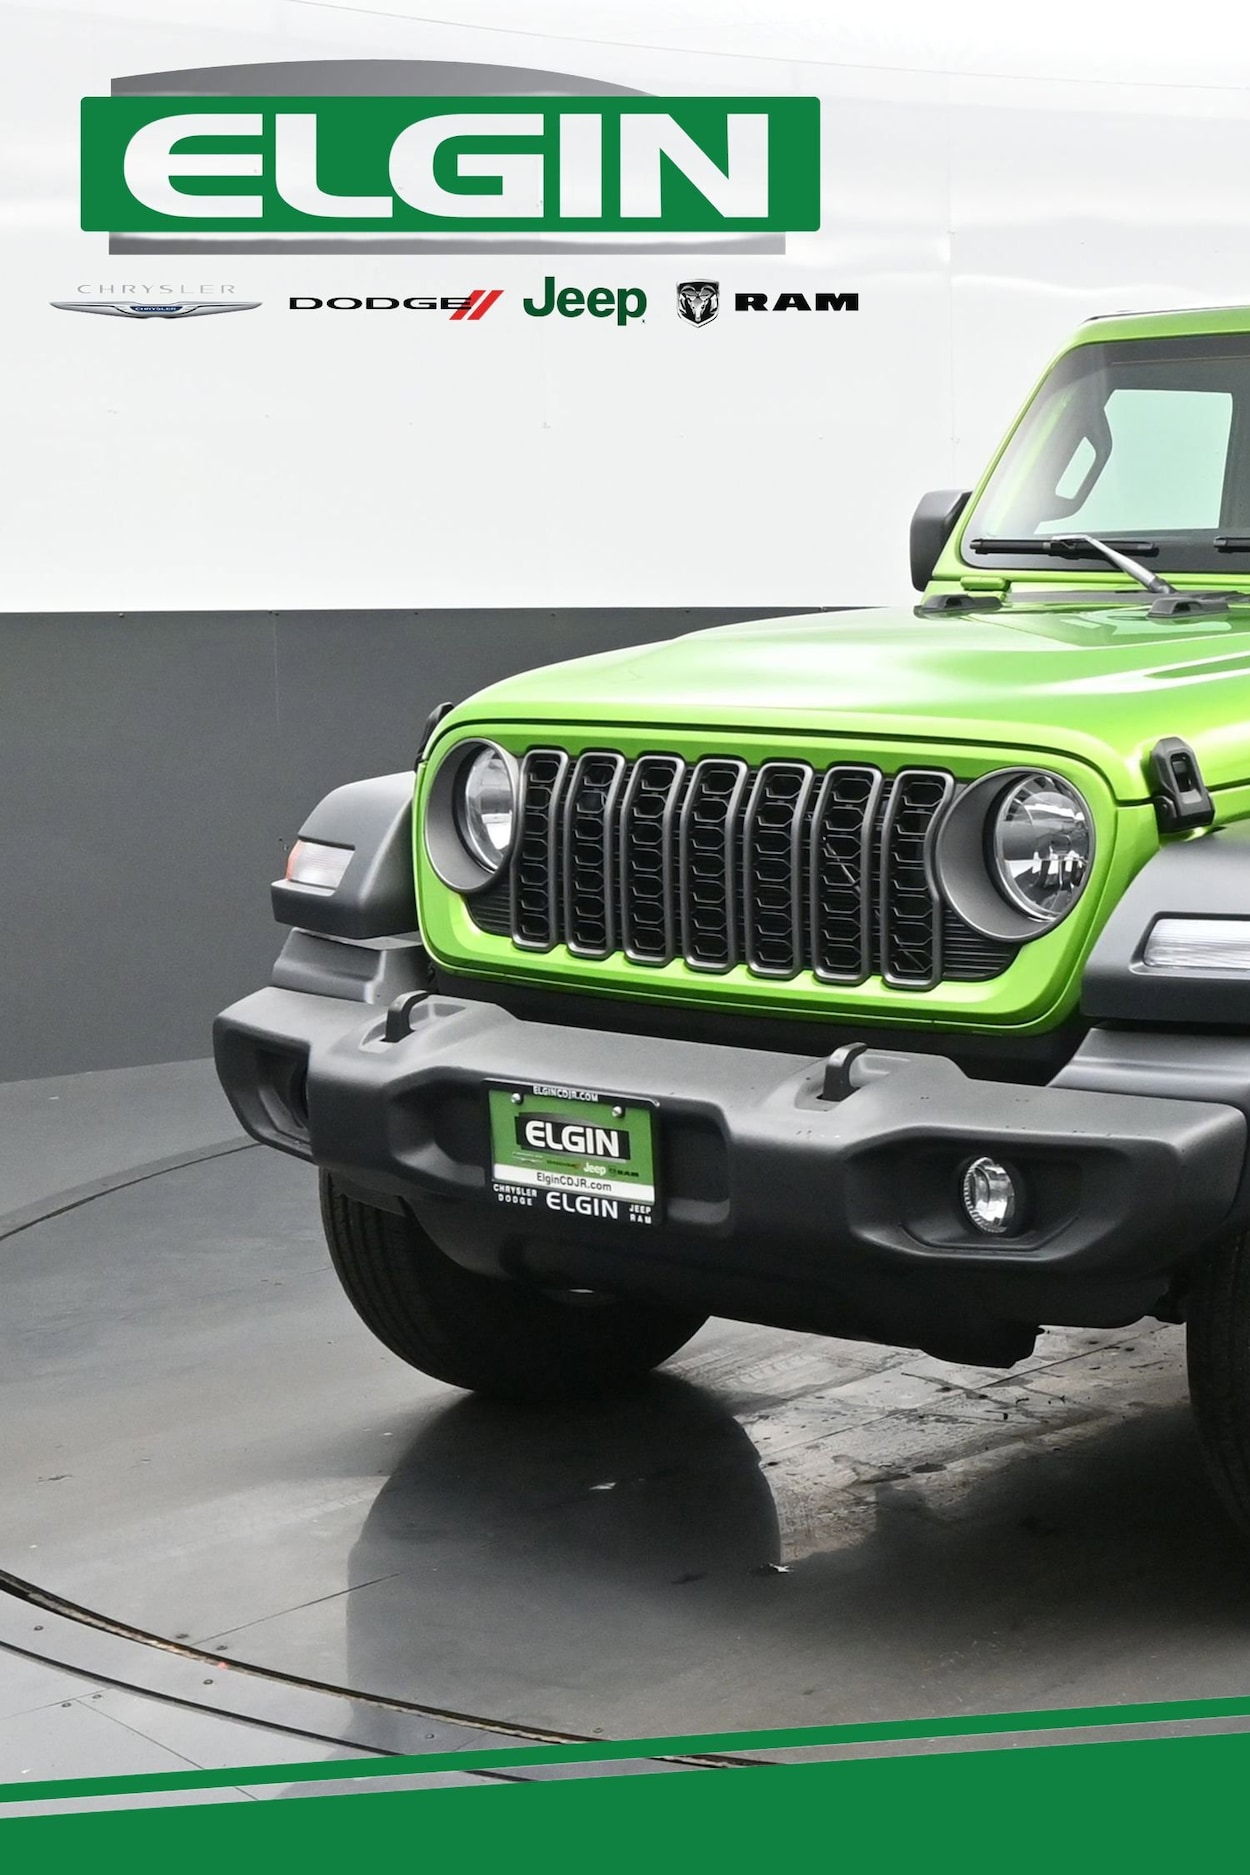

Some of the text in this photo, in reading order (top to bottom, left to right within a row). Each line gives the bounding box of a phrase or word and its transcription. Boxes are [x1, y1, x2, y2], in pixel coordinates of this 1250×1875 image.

[533, 1085, 599, 1102] ELGINCDJR.COM
[525, 1120, 620, 1158] ELGIN
[583, 1162, 607, 1176] Jeep
[536, 1172, 612, 1192] ElginCDJR.com
[493, 1184, 537, 1197] CHRYSLER
[498, 1194, 533, 1207] DODGE
[546, 1191, 619, 1220] ELGIN
[629, 1204, 652, 1215] JEEP
[629, 1214, 652, 1225] RAM
